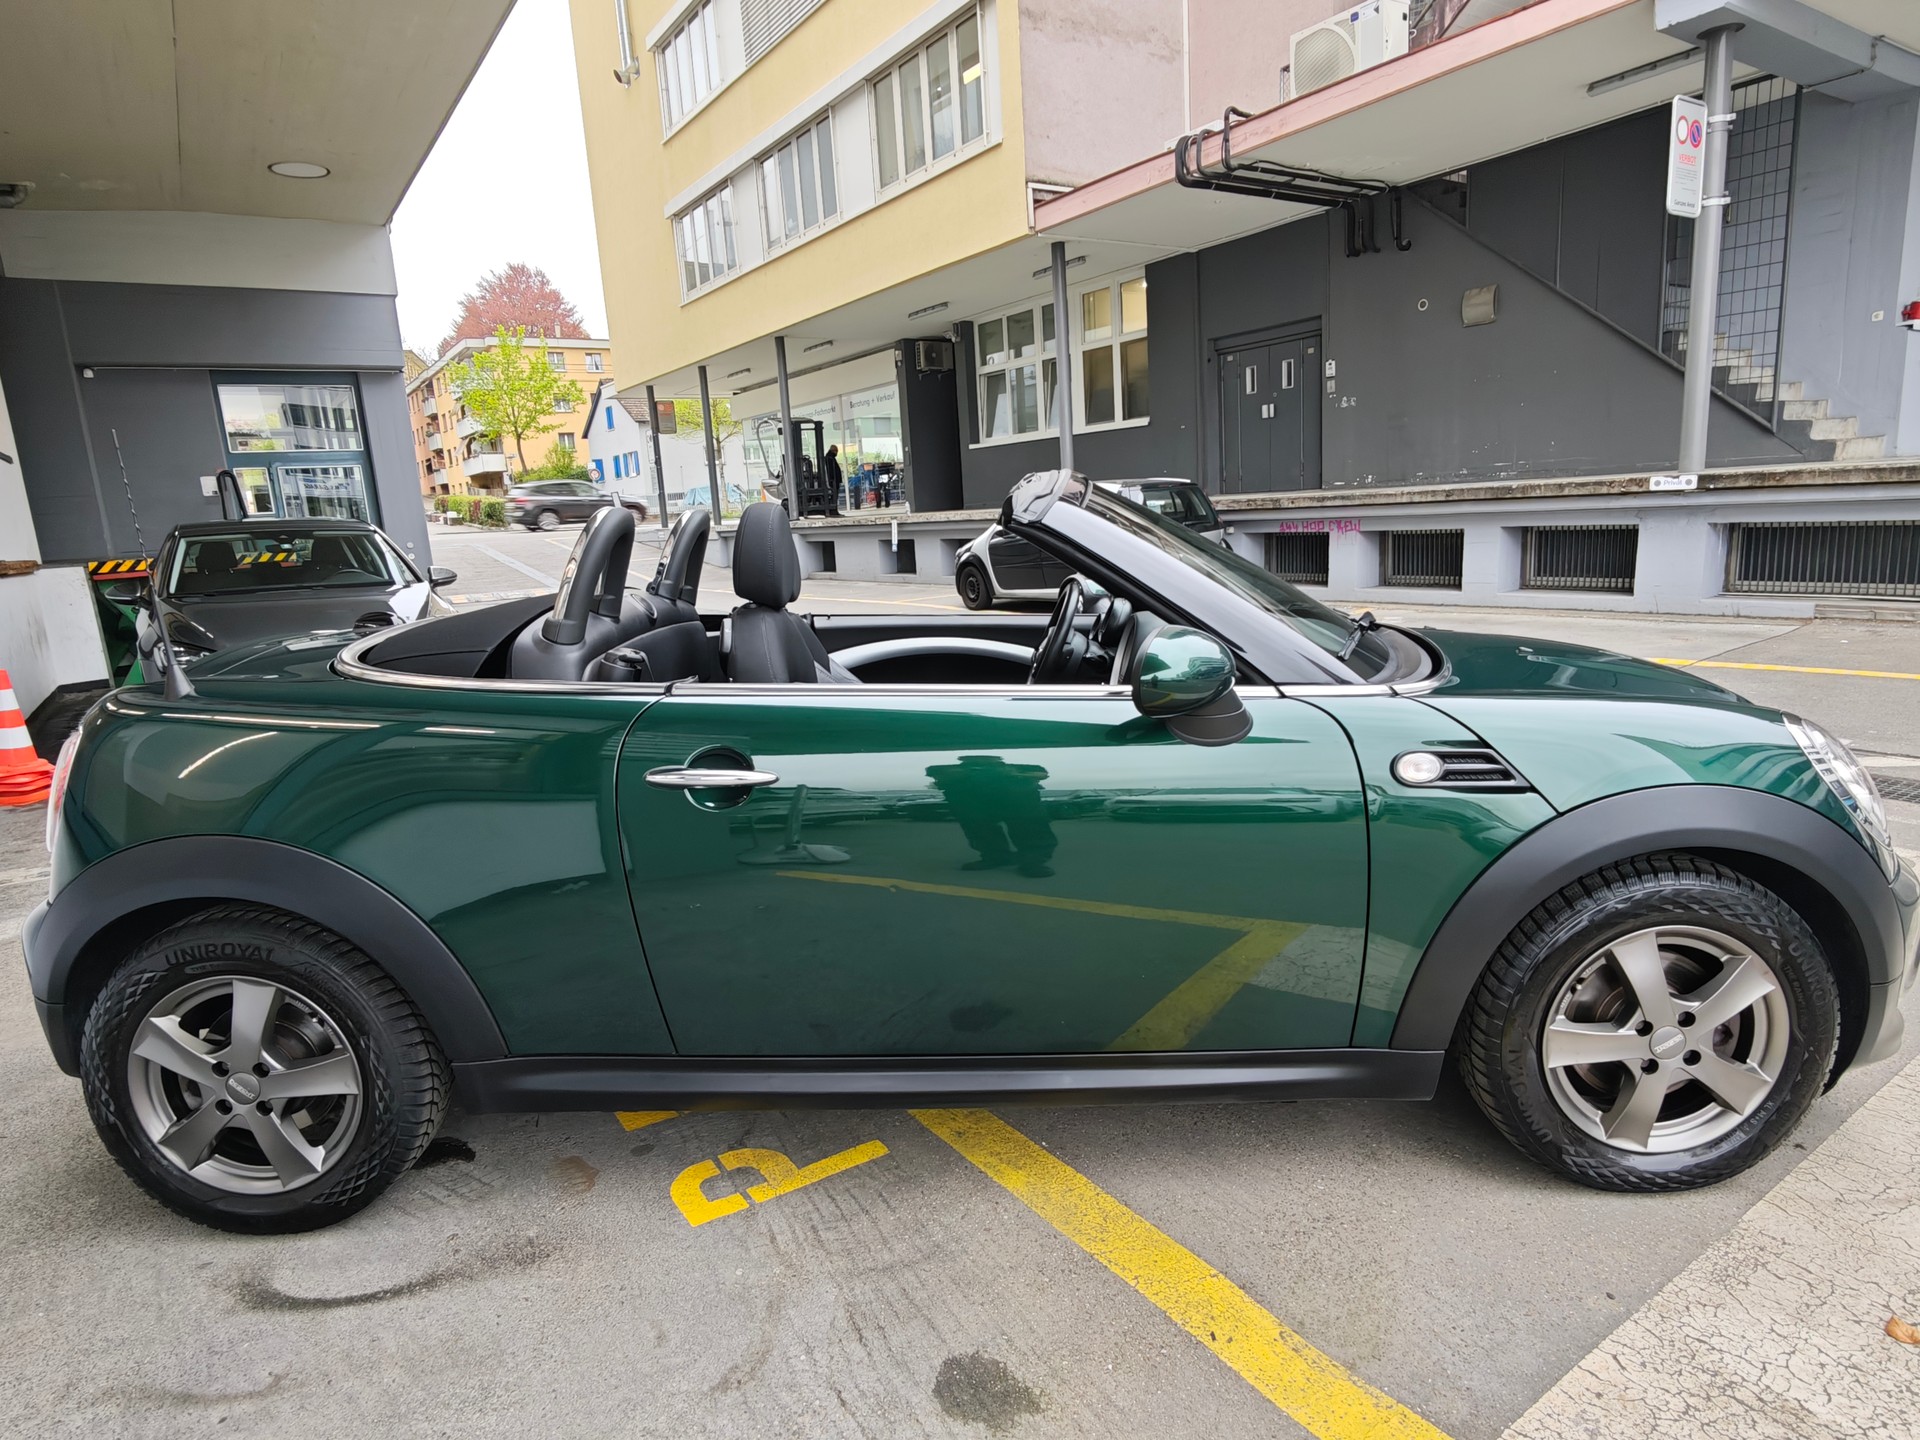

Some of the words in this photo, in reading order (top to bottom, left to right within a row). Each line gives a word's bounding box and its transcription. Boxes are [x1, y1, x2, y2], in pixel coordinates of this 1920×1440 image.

[849, 399, 870, 408] Beratung
[876, 391, 895, 402] Verkauf
[165, 942, 275, 966] UNIROYAL
